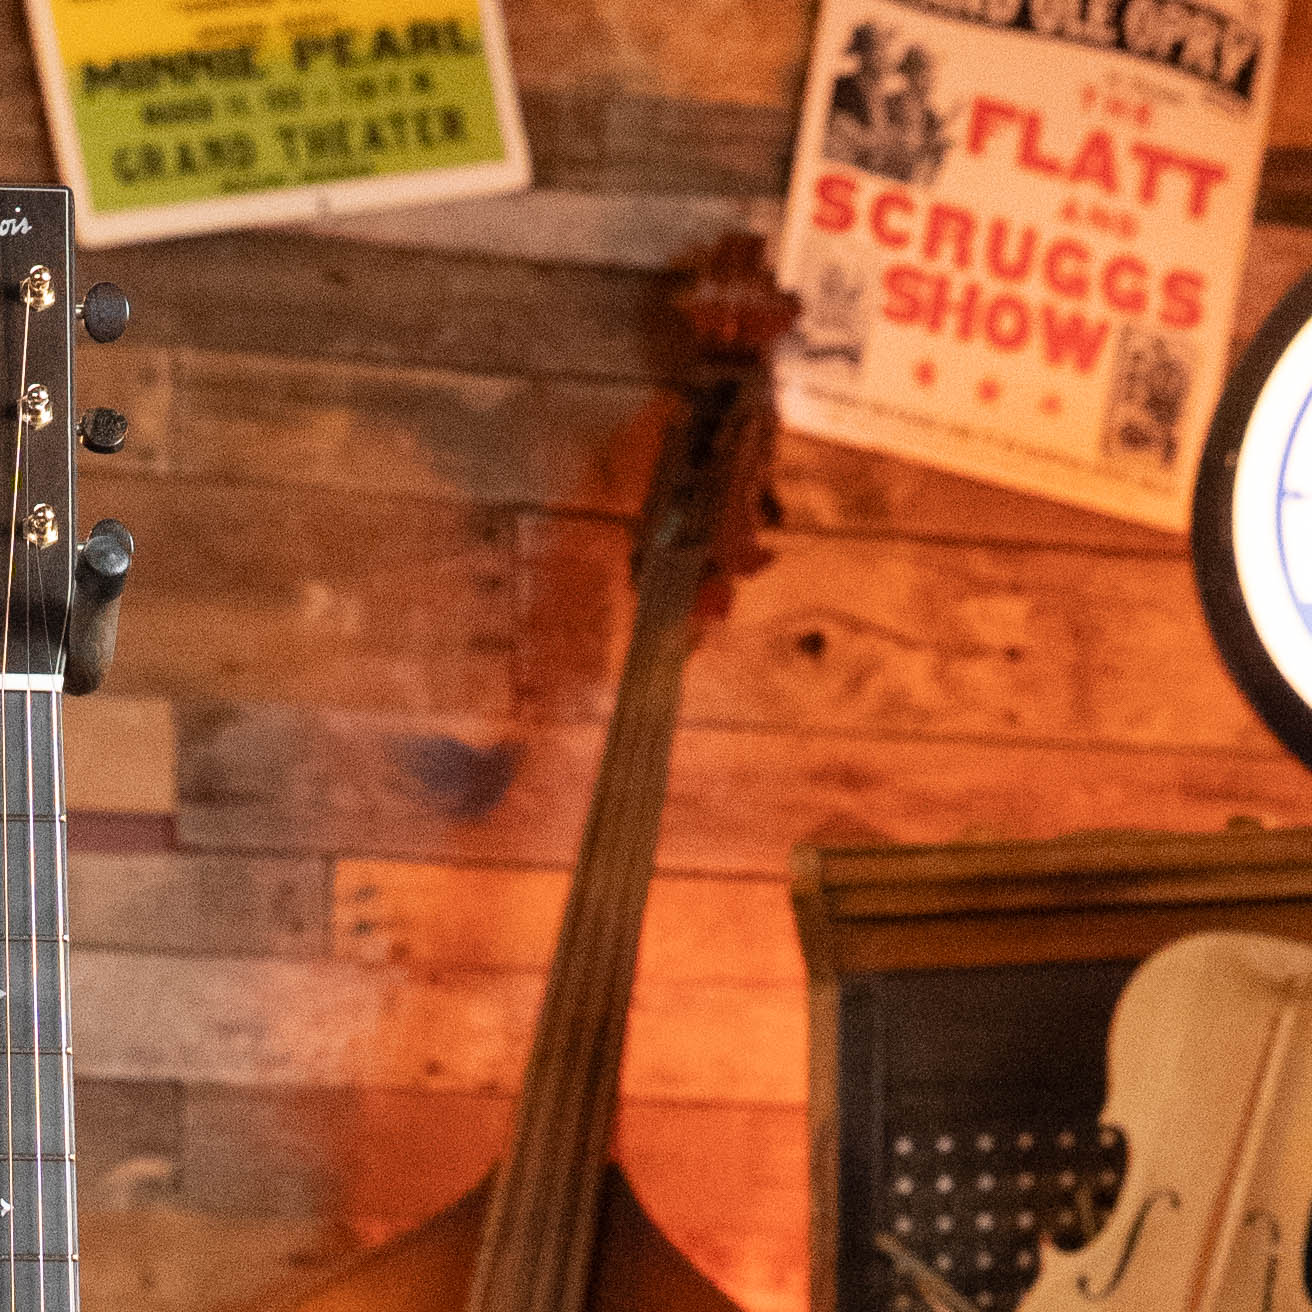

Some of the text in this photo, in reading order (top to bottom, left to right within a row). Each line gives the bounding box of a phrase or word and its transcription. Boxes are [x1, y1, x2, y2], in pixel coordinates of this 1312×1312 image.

[83, 45, 264, 92] MINNIE
[294, 19, 481, 71] PEARL
[112, 134, 257, 186] GRAND
[276, 106, 469, 160] THEATER
[967, 97, 1229, 220] FLATT
[812, 173, 1205, 330] SCRUGGS
[882, 264, 1110, 375] SHOW
